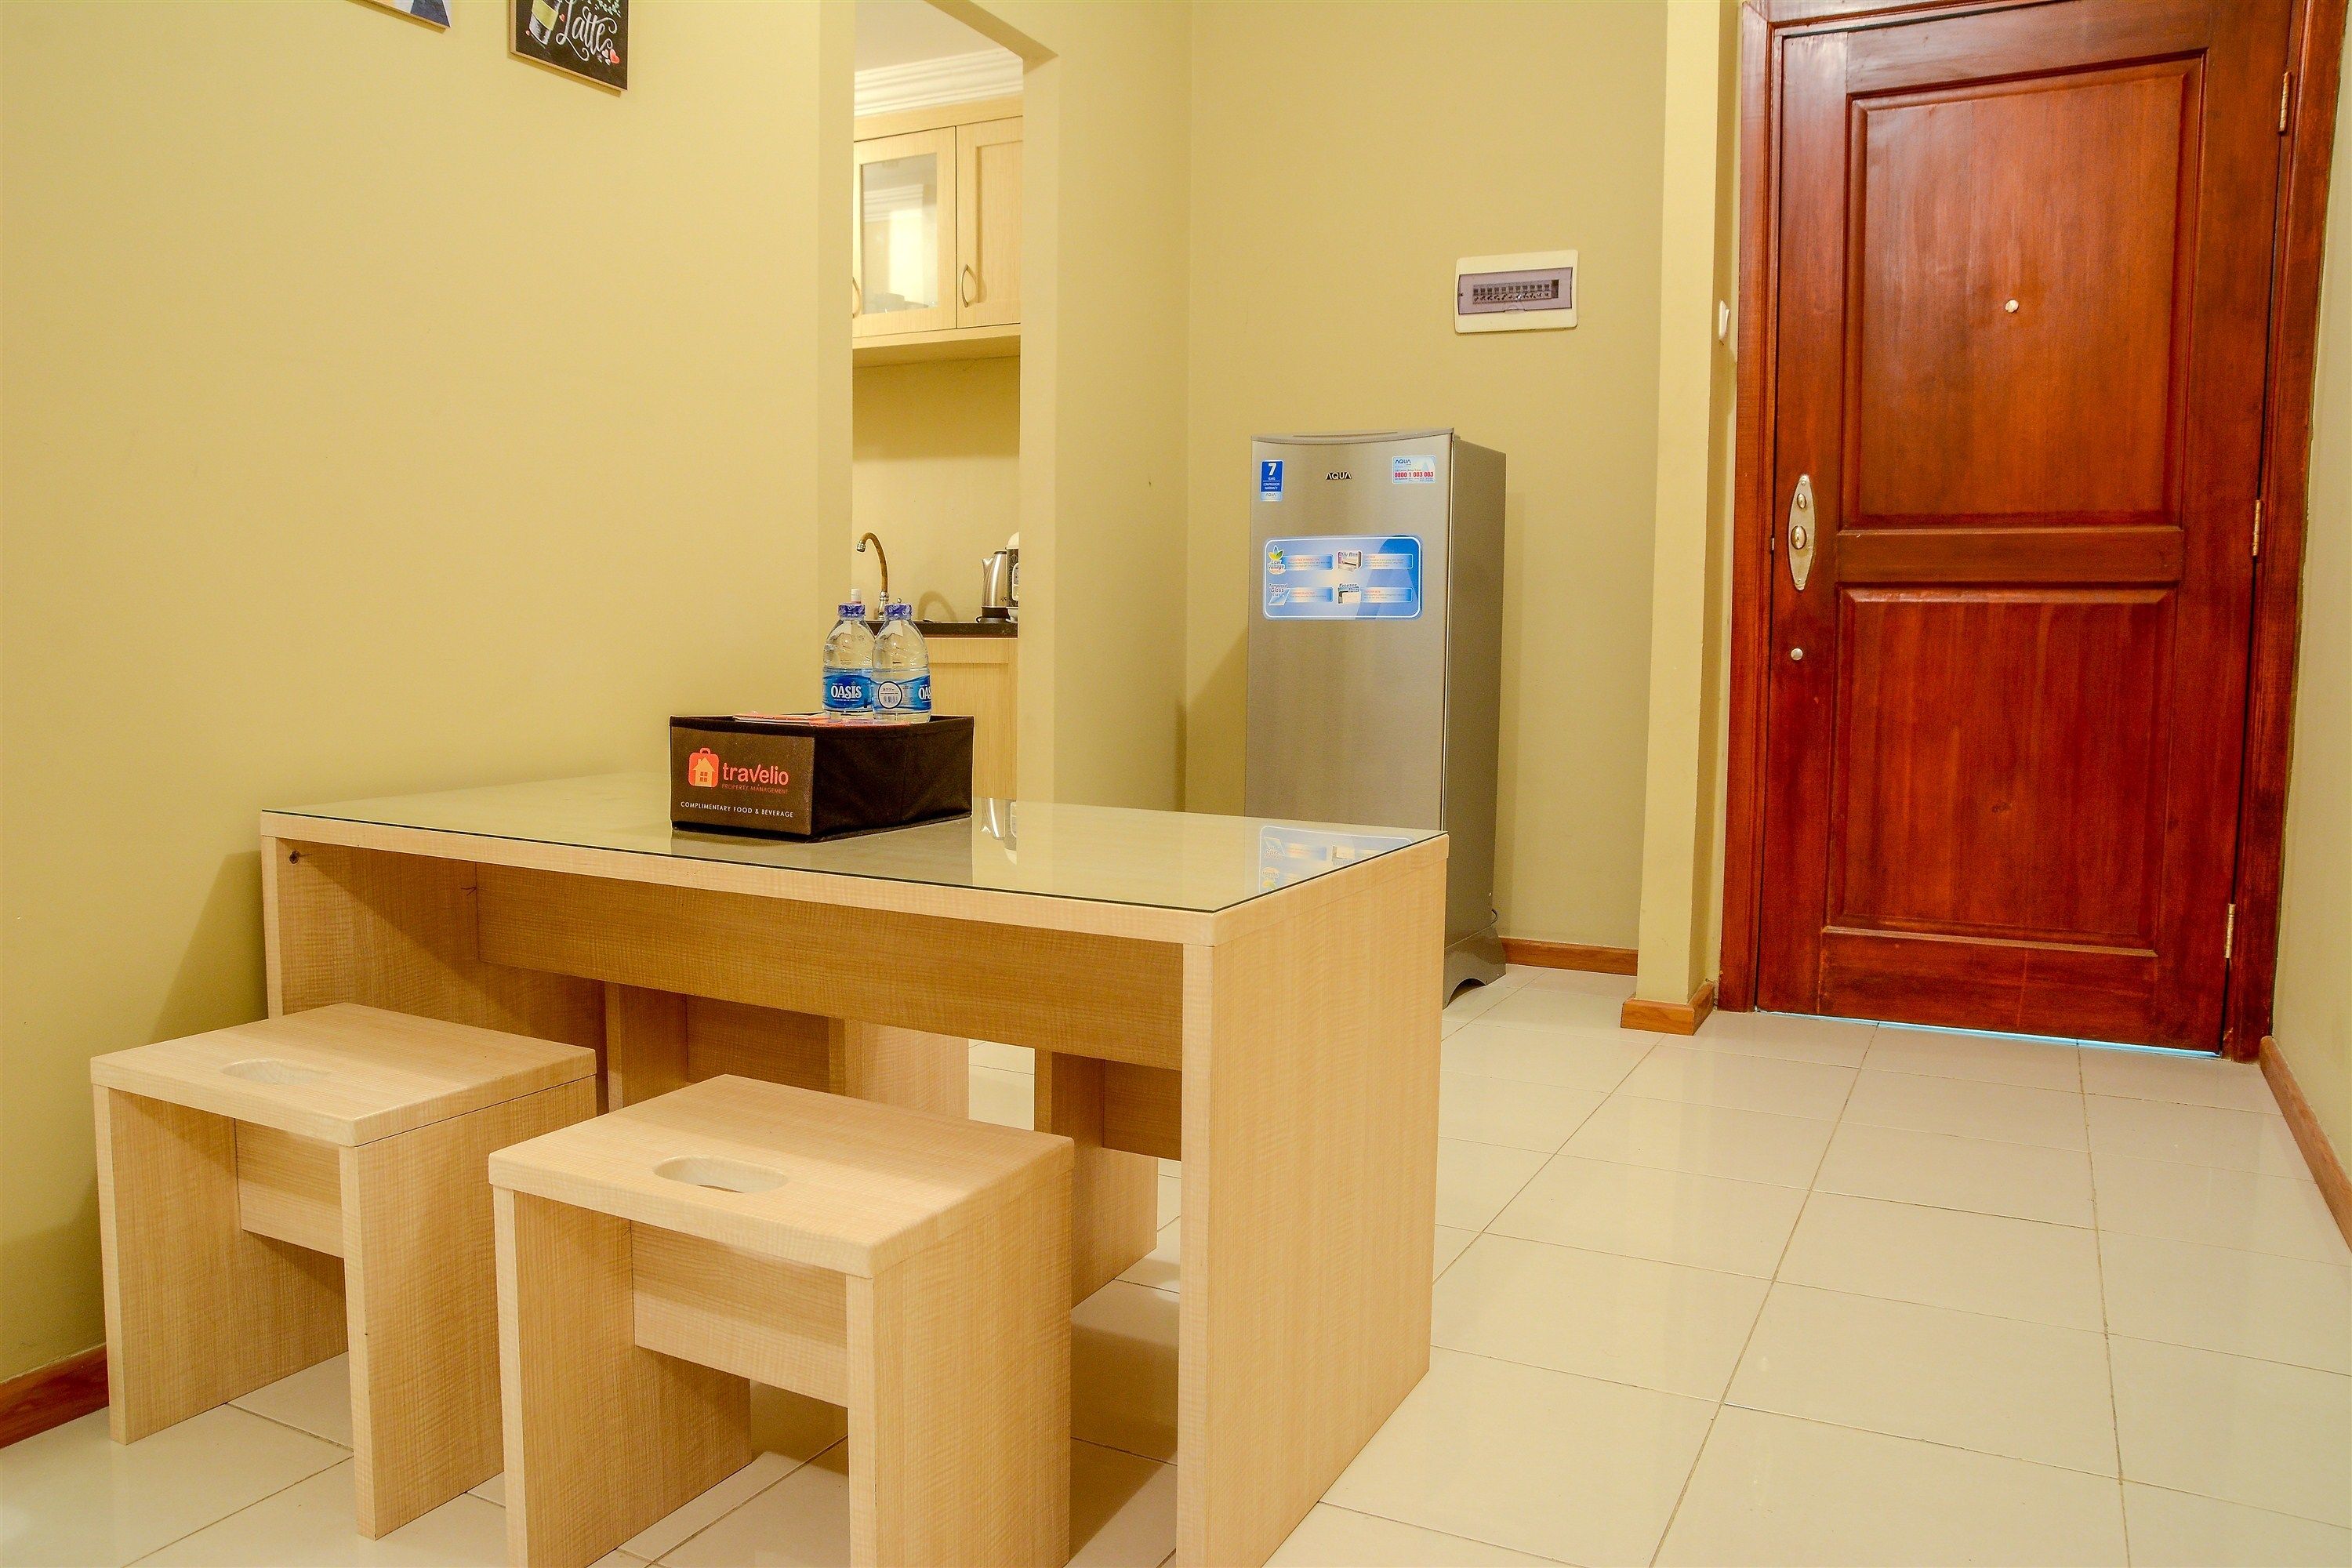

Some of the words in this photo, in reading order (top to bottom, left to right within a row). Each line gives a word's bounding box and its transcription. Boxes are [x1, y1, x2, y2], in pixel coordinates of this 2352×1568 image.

[556, 0, 618, 61] Latte
[1268, 463, 1277, 476] 7
[1325, 471, 1352, 481] AQUA
[831, 685, 862, 699] OASIS
[722, 762, 789, 786] travelio
[750, 786, 788, 794] MANAGEMENT
[681, 801, 731, 811] COMPLIMENTARY
[761, 808, 793, 818] BEVERAGE
